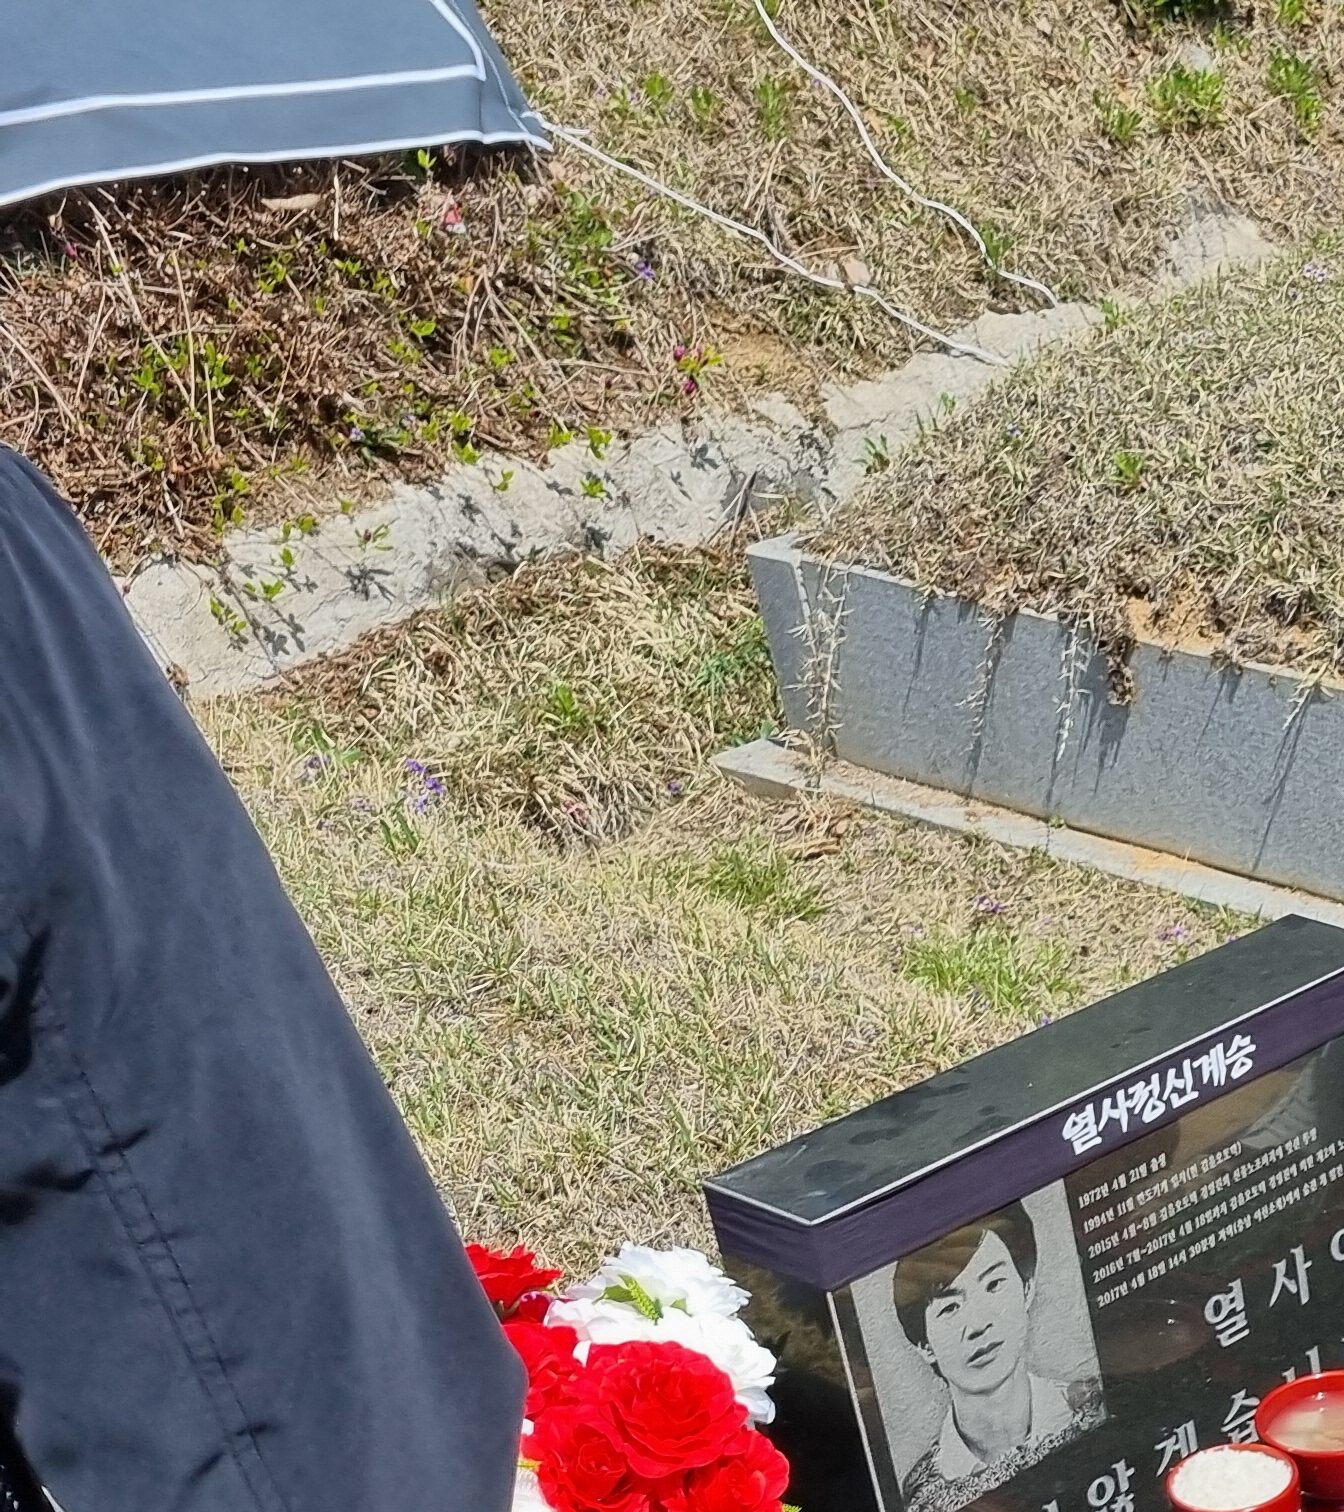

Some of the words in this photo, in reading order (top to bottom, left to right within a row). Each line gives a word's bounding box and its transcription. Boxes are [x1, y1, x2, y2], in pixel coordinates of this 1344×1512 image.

[1062, 1034, 1256, 1155] 열사정신계승
[1079, 1183, 1109, 1208] 1972년
[1129, 1163, 1147, 1183] 21일
[1088, 1232, 1119, 1258] 2015년
[1093, 1257, 1124, 1283] 2016년
[1097, 1281, 1128, 1308] 2017년
